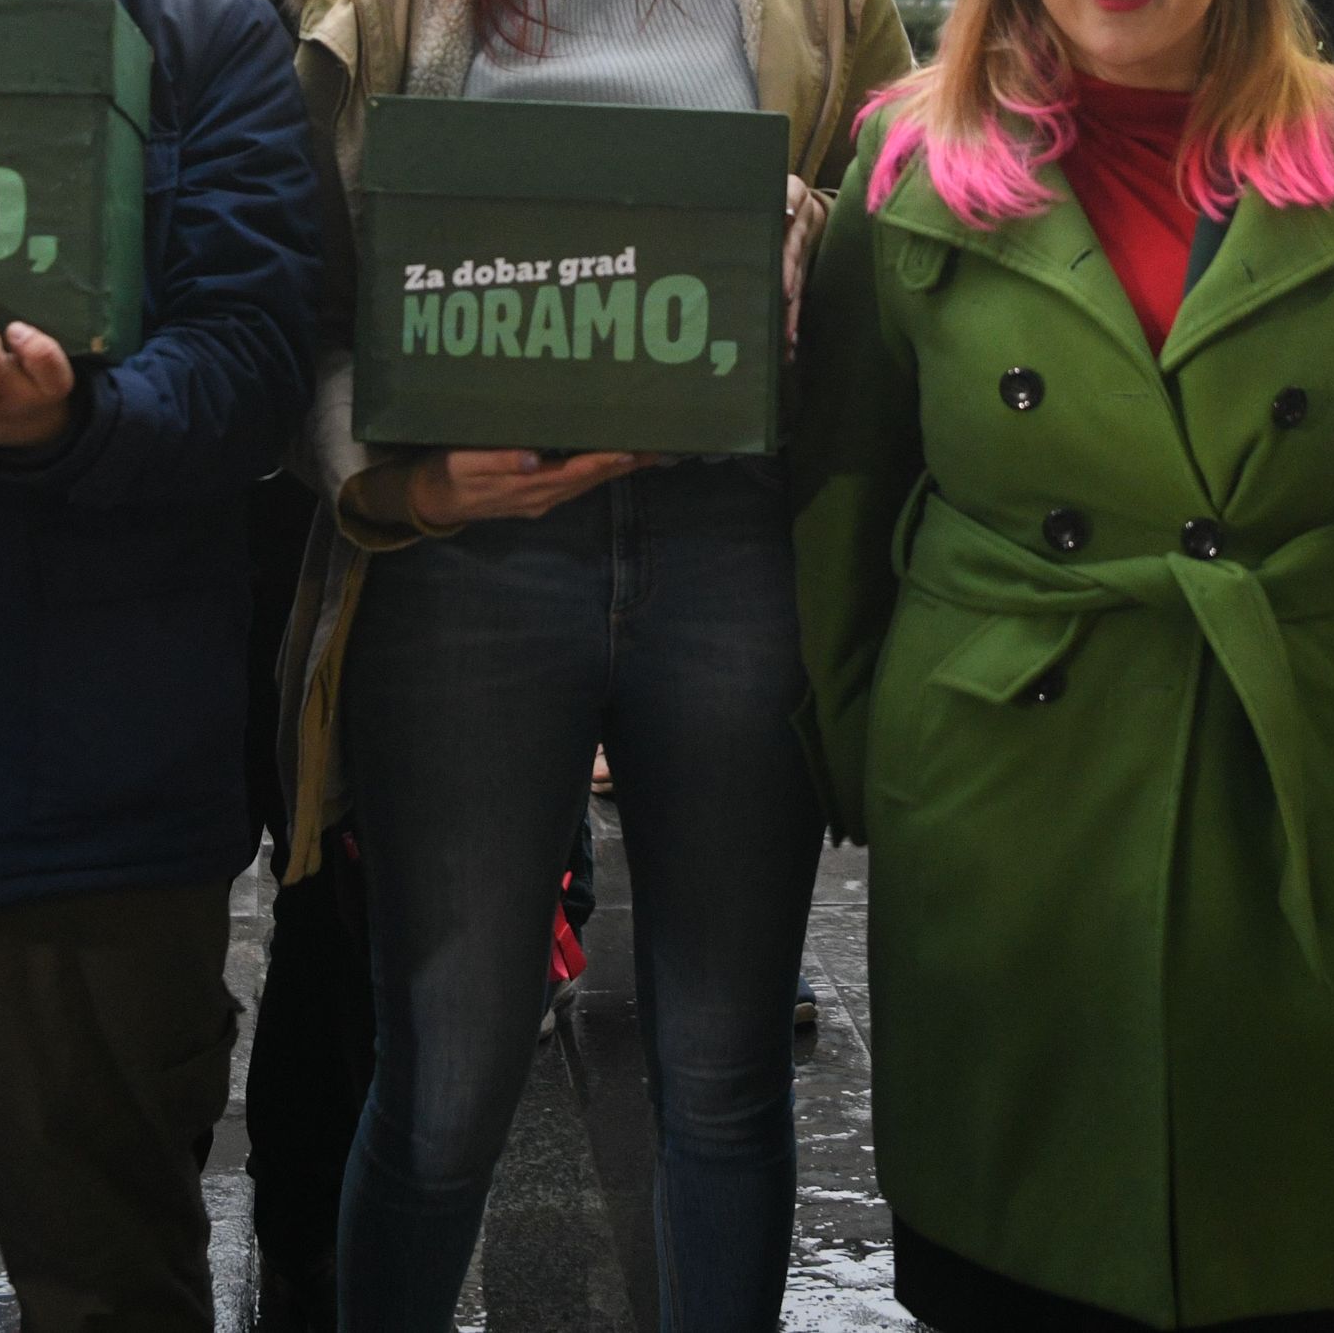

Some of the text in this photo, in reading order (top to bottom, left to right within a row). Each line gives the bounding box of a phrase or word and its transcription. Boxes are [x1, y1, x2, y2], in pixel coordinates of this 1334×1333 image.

[404, 246, 636, 291] Za dobar grad
[402, 273, 738, 377] MORAMO,
